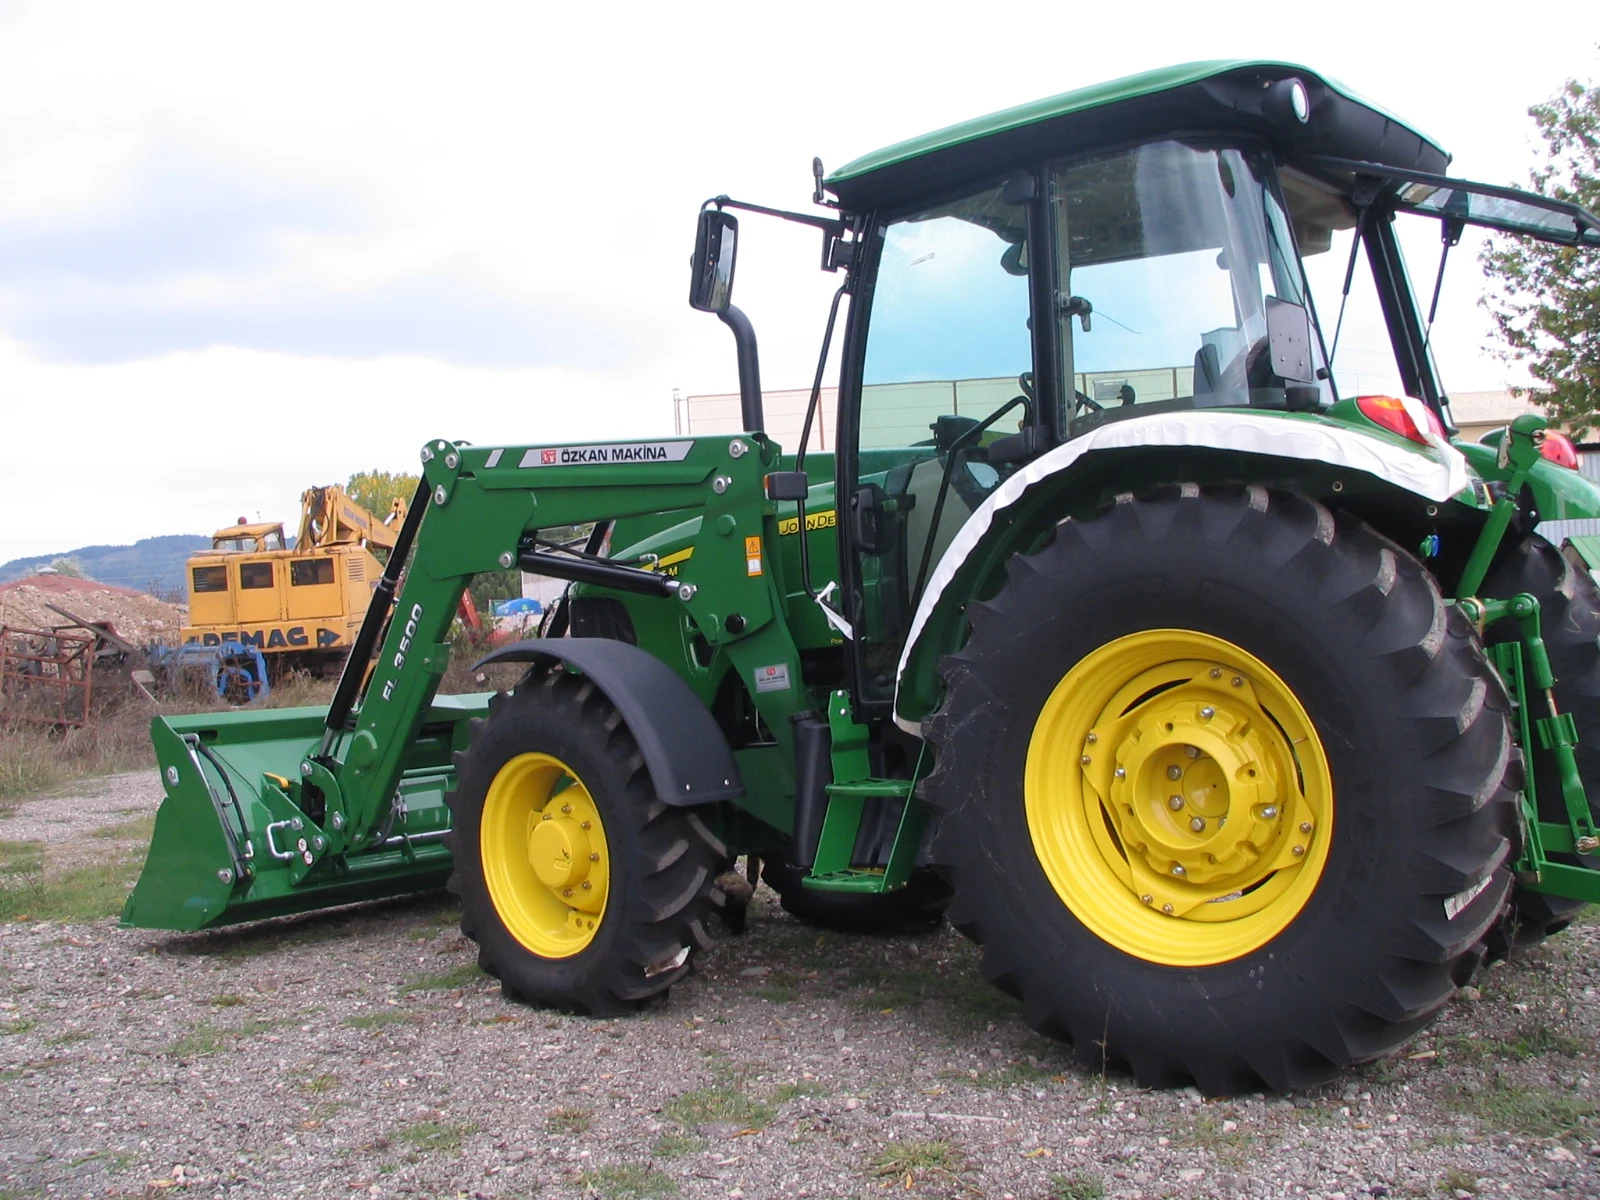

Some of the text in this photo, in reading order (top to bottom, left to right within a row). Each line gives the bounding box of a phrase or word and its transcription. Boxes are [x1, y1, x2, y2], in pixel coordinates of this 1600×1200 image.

[561, 448, 608, 463] ÖZKAN
[612, 444, 667, 461] MAKİNA
[781, 518, 816, 534] JON
[203, 626, 309, 649] DEMAG
[382, 603, 423, 701] FL 3500
